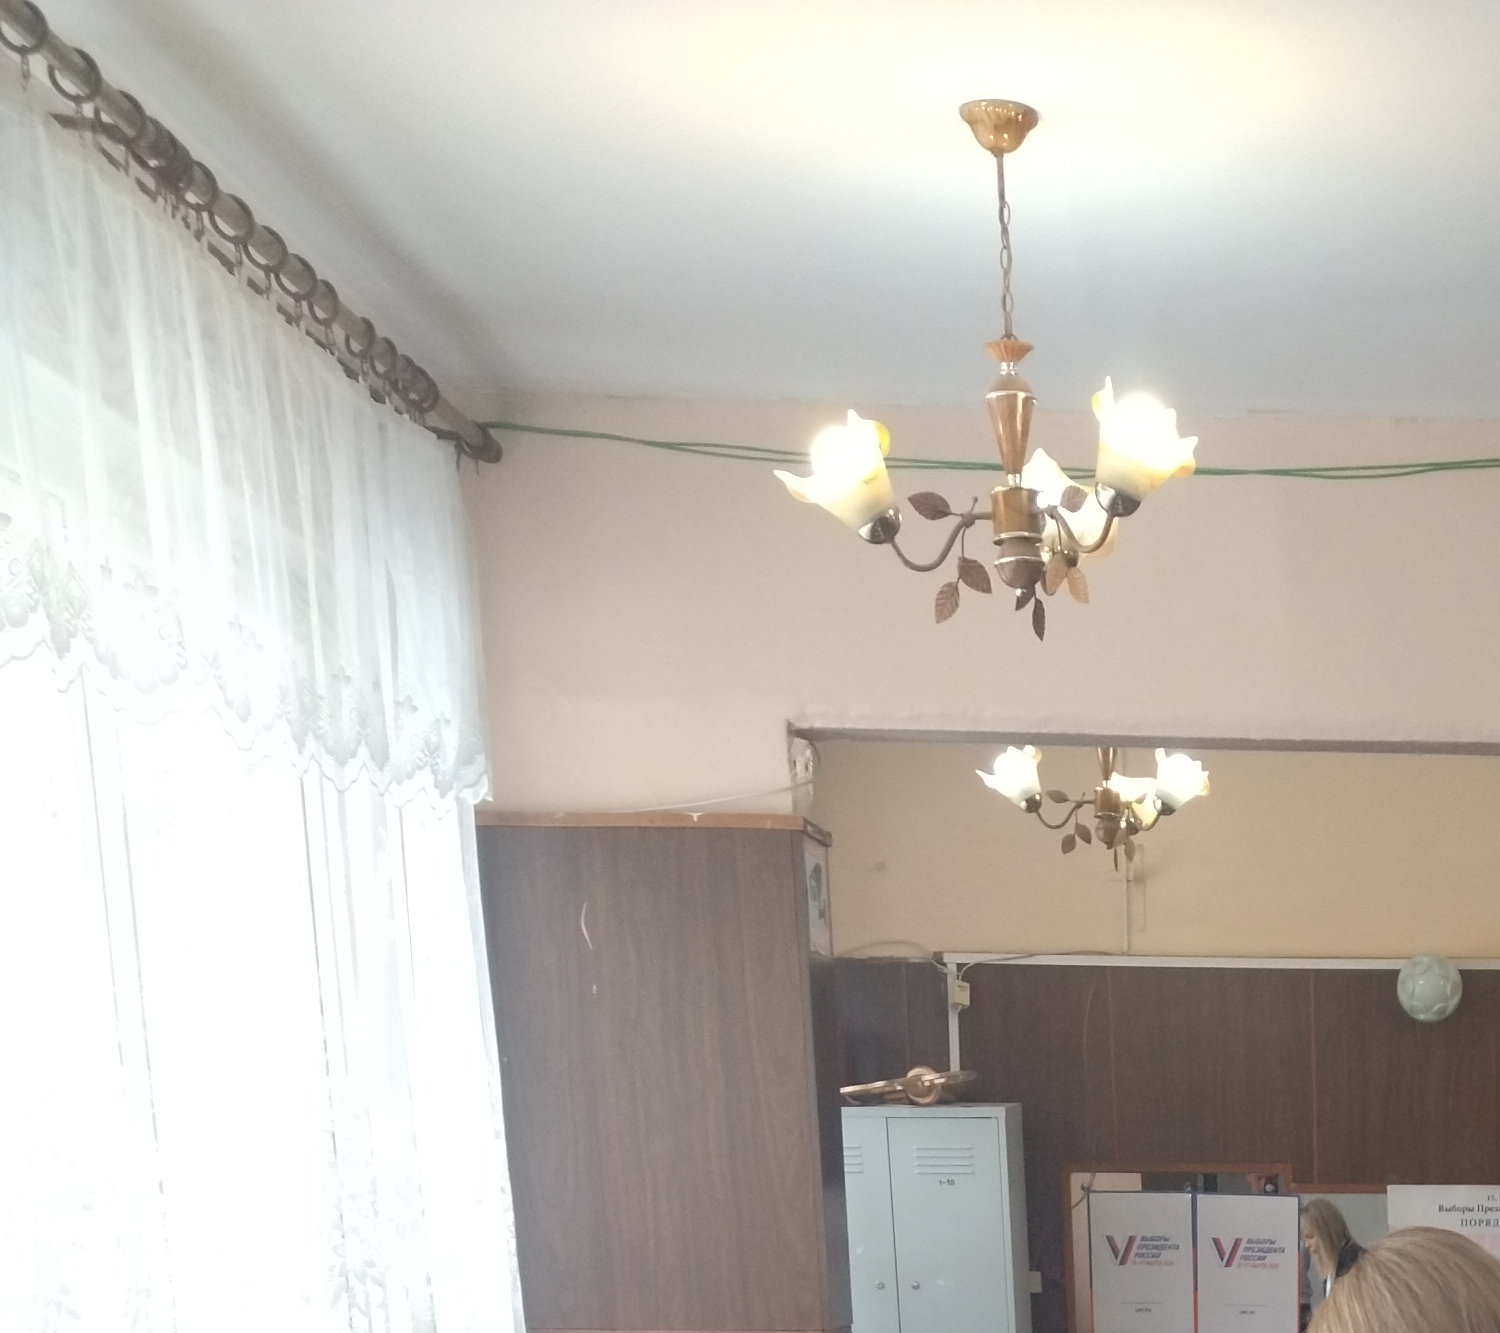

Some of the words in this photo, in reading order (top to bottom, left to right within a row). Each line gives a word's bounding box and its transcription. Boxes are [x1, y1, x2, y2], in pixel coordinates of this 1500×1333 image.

[1438, 1204, 1475, 1214] Выборы
[1136, 1243, 1180, 1251] ПРЕЗИДЕНТА
[1242, 1246, 1285, 1254] ПРЕЗИДЕНТА
